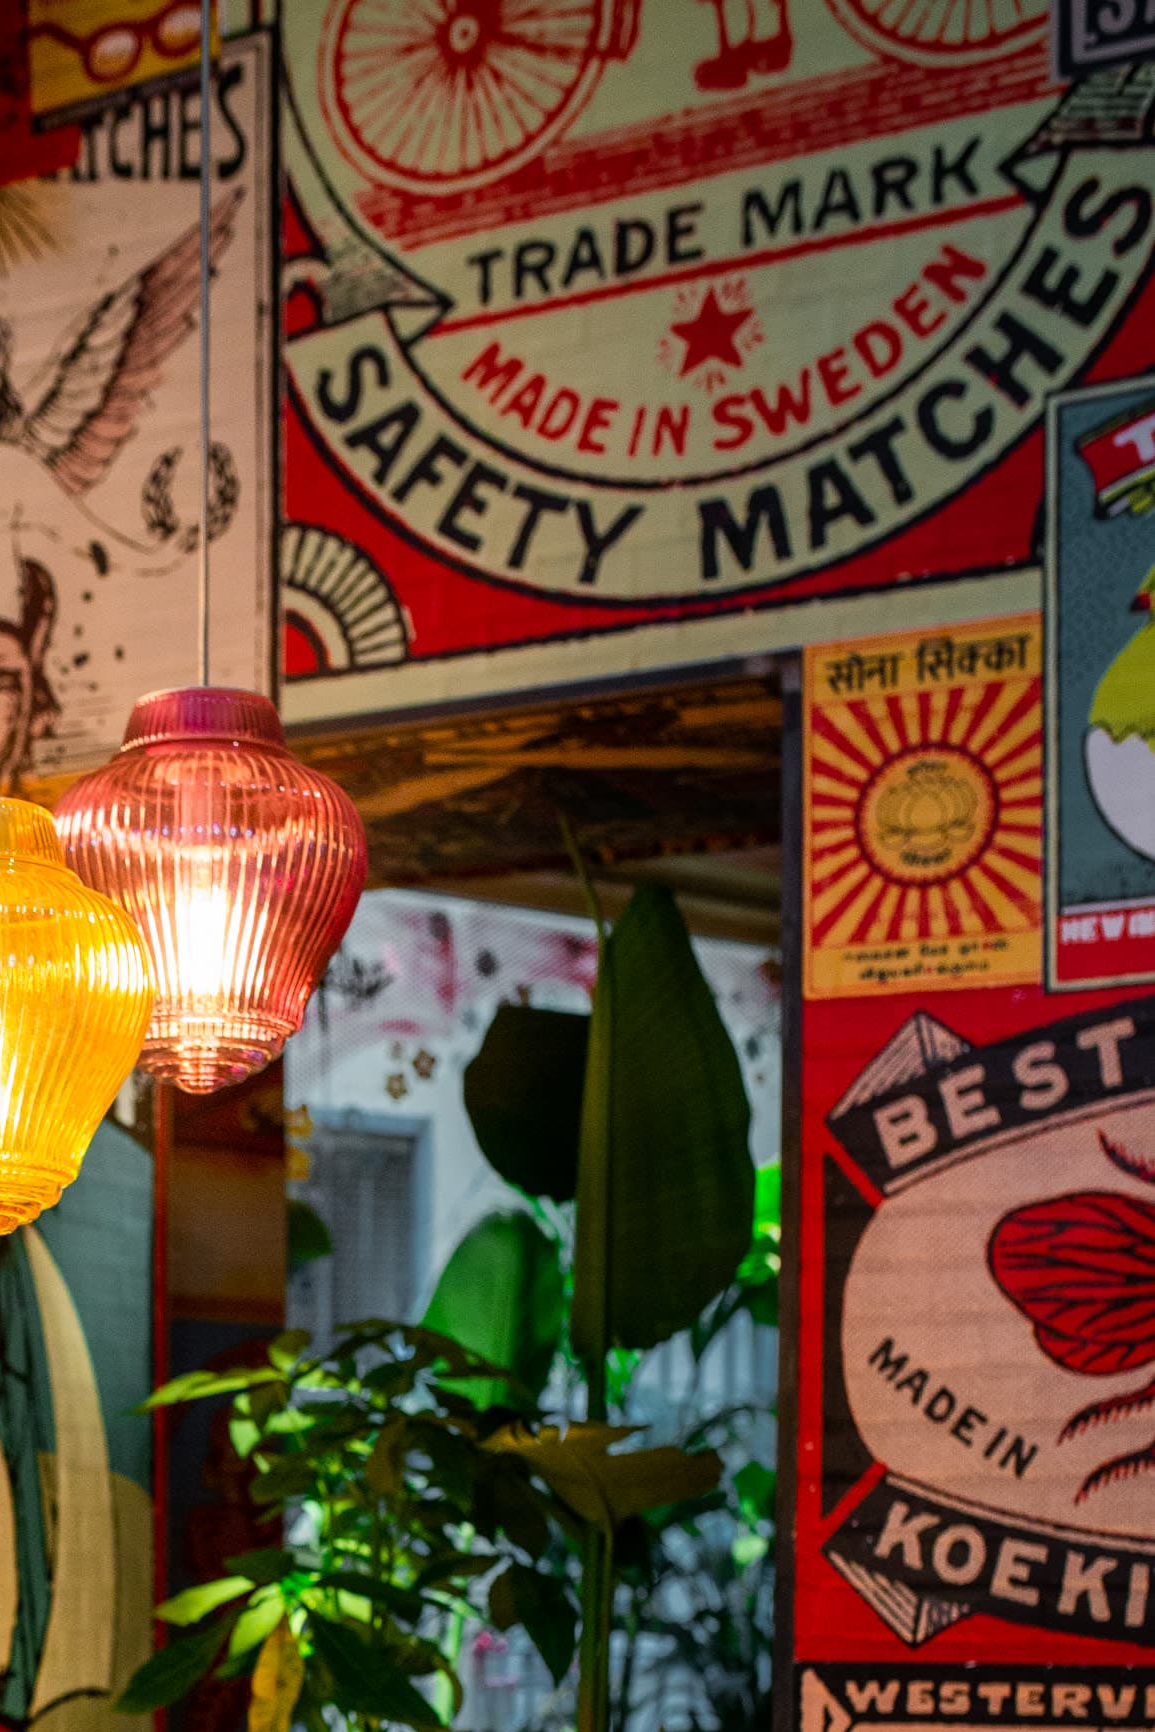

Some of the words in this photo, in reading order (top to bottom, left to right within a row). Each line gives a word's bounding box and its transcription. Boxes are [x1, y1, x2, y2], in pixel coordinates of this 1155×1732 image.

[467, 203, 706, 307] TRADE
[741, 135, 986, 248] MARK
[315, 345, 645, 585] SAFETY
[699, 174, 1154, 581] MATCHES
[461, 342, 618, 457] MADE
[628, 405, 689, 458] IN
[712, 242, 989, 452] SWEDEN
[873, 1016, 1136, 1170] BEST
[868, 1337, 987, 1448] MADE
[984, 1424, 1040, 1479] IN
[874, 1500, 1151, 1628] KOEKI
